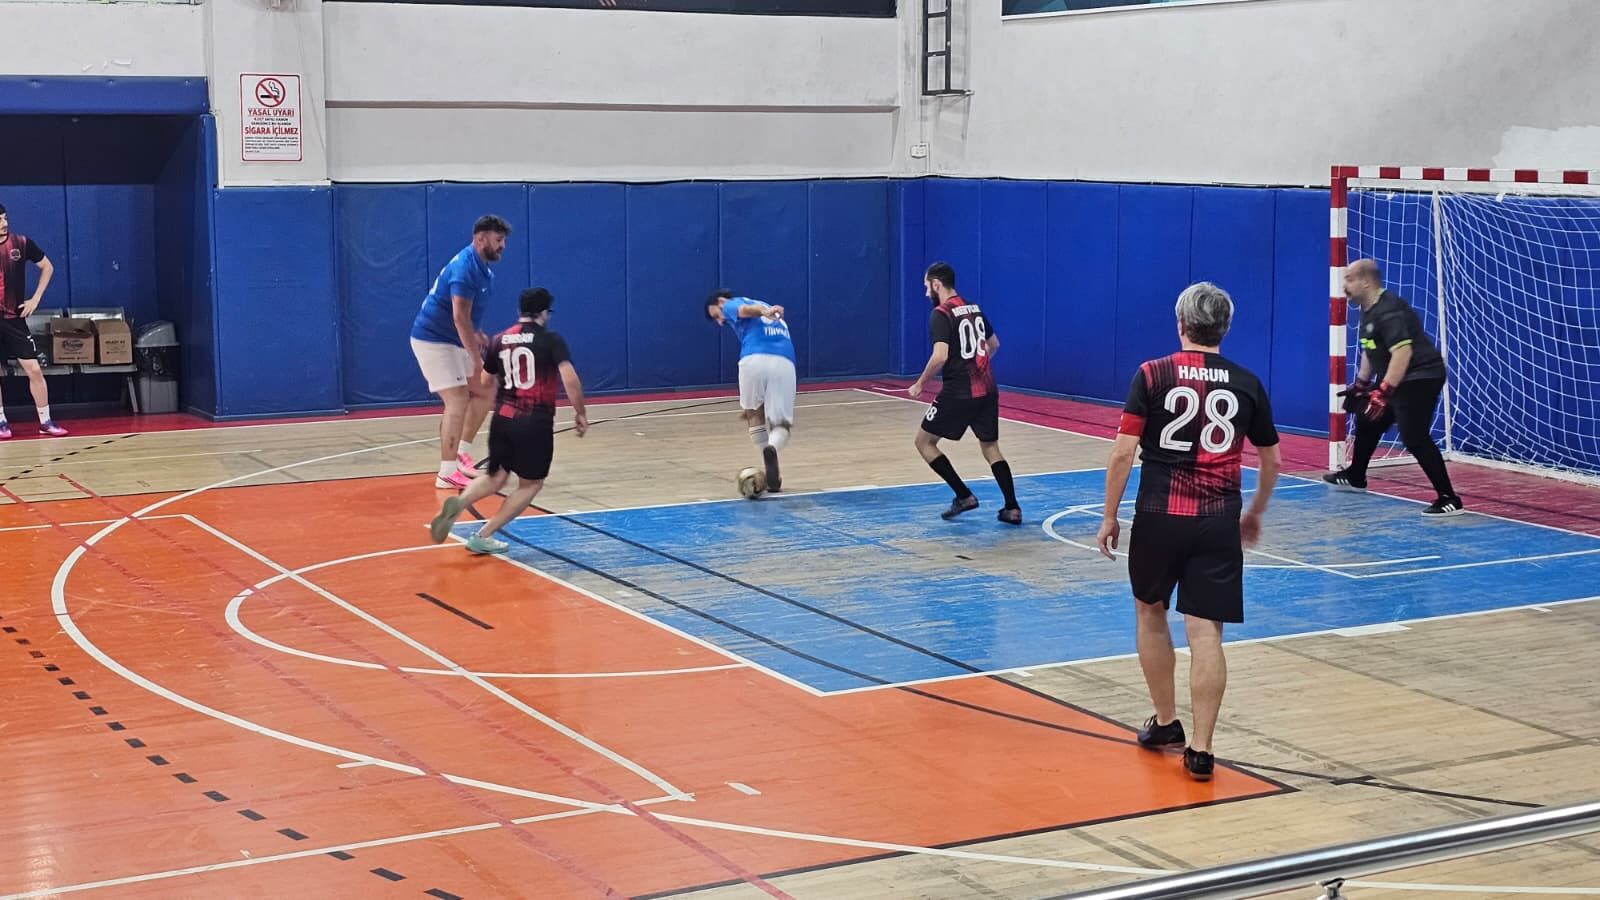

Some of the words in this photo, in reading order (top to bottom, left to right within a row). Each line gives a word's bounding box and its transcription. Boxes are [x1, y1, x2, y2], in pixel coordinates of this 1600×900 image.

[248, 108, 271, 116] YASAL
[273, 108, 294, 117] UYARI
[244, 126, 270, 134] SİGARA
[272, 126, 299, 136] İÇİLMEZ
[499, 346, 535, 390] 10
[1178, 365, 1230, 383] HARUN
[1160, 386, 1239, 453] 28
